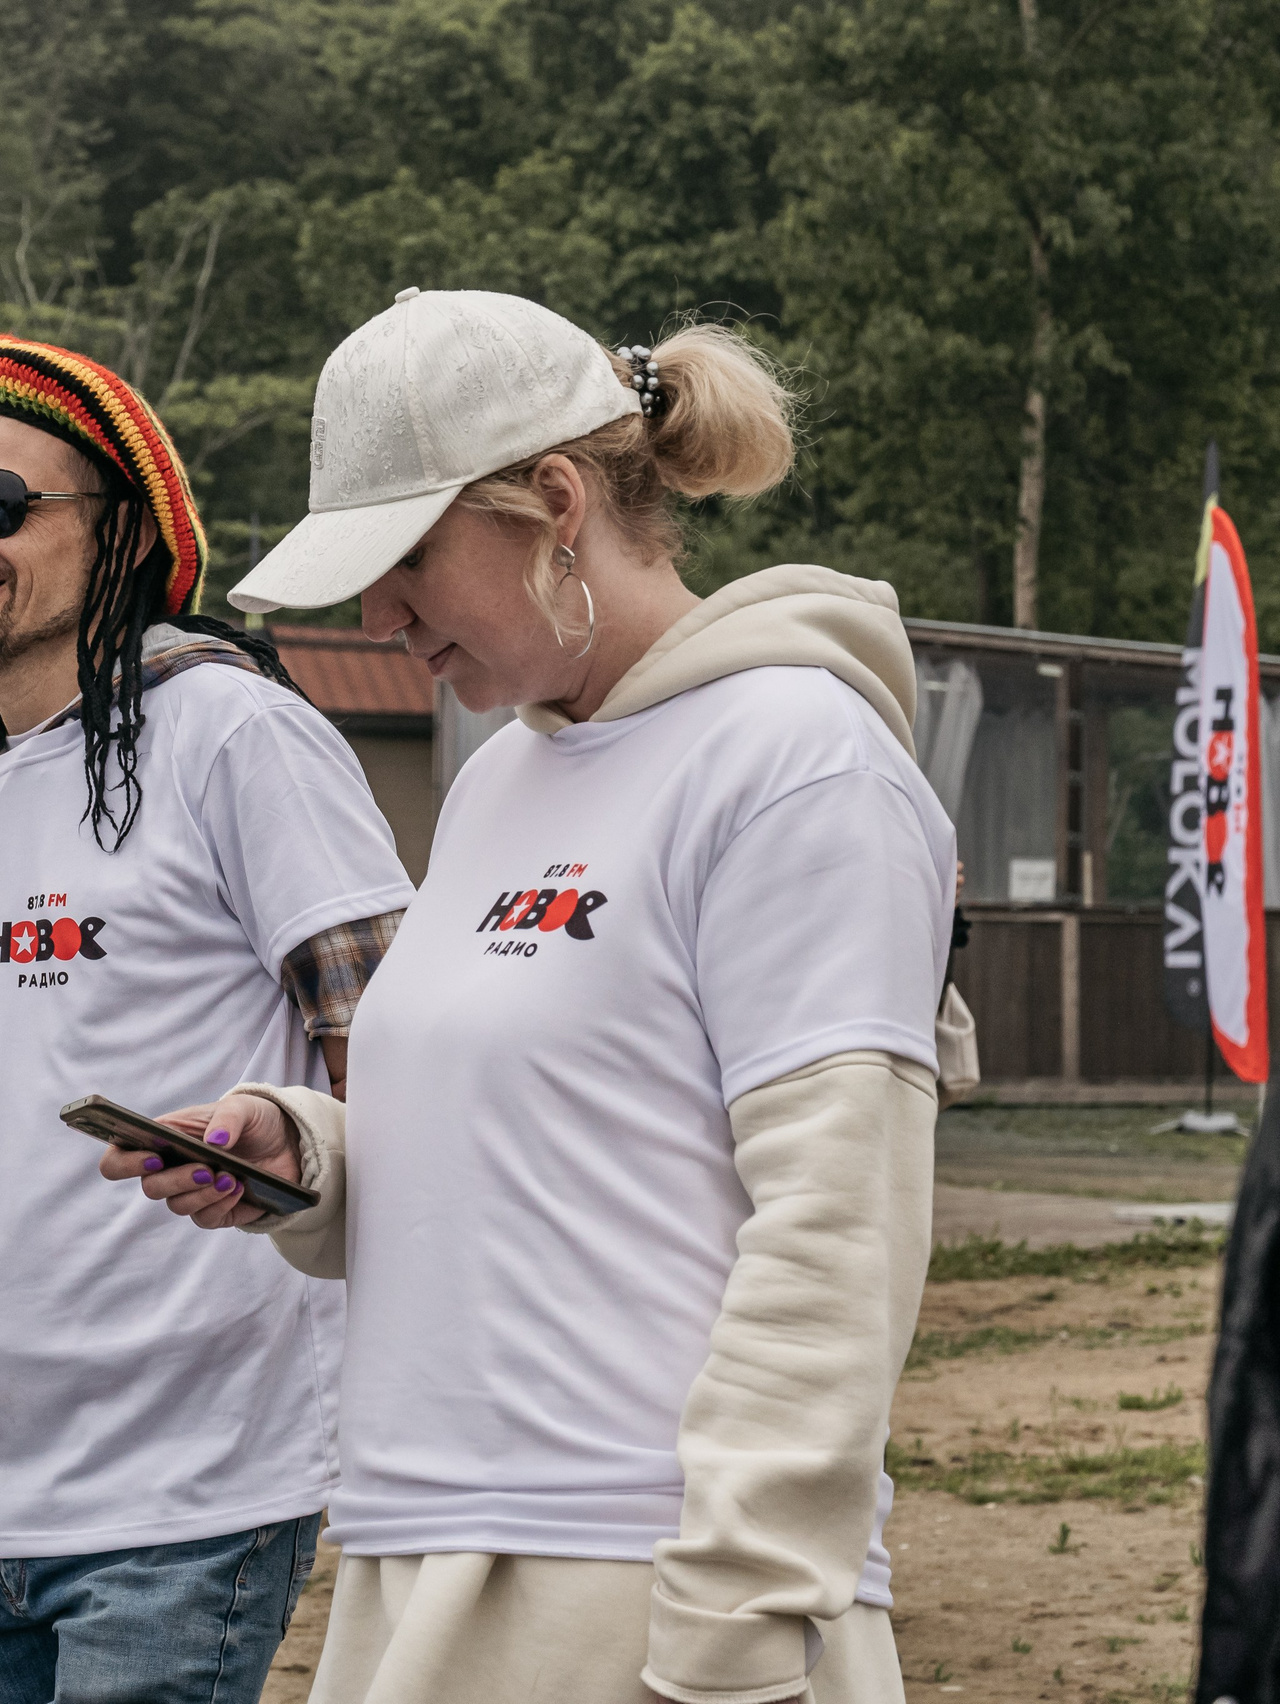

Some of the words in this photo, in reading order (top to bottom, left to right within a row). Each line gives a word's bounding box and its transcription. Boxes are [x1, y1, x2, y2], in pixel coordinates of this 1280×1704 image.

[566, 864, 588, 877] FM
[48, 893, 67, 907] FM
[484, 941, 538, 958] РАДИО
[18, 971, 69, 989] РАДИО
